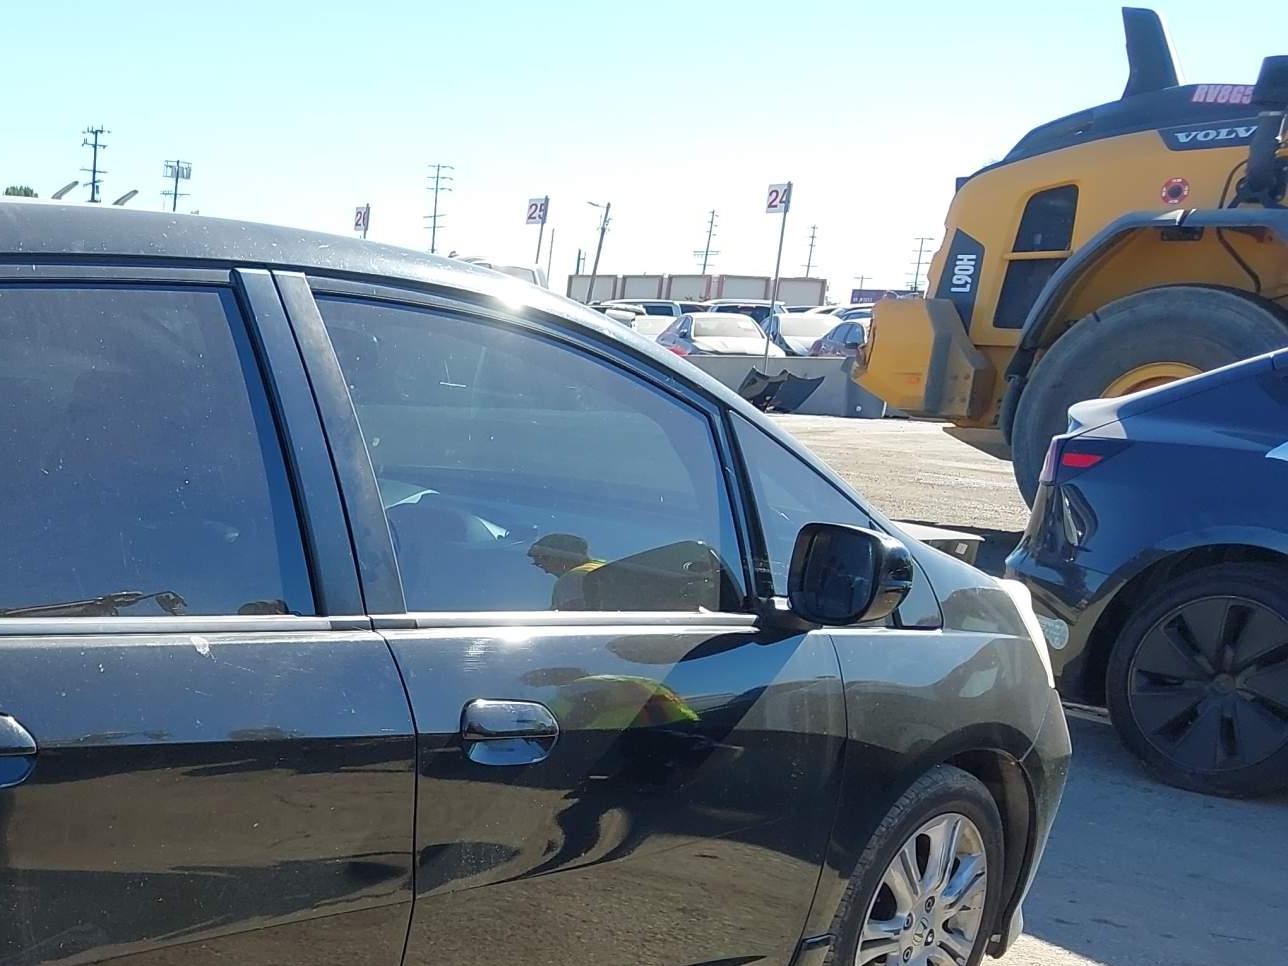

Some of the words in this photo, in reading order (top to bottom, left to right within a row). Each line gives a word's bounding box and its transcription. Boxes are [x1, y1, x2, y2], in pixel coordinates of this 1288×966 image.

[1174, 126, 1259, 143] VOLV
[767, 189, 790, 209] 24
[528, 203, 545, 220] 25
[950, 254, 977, 293] L90H
